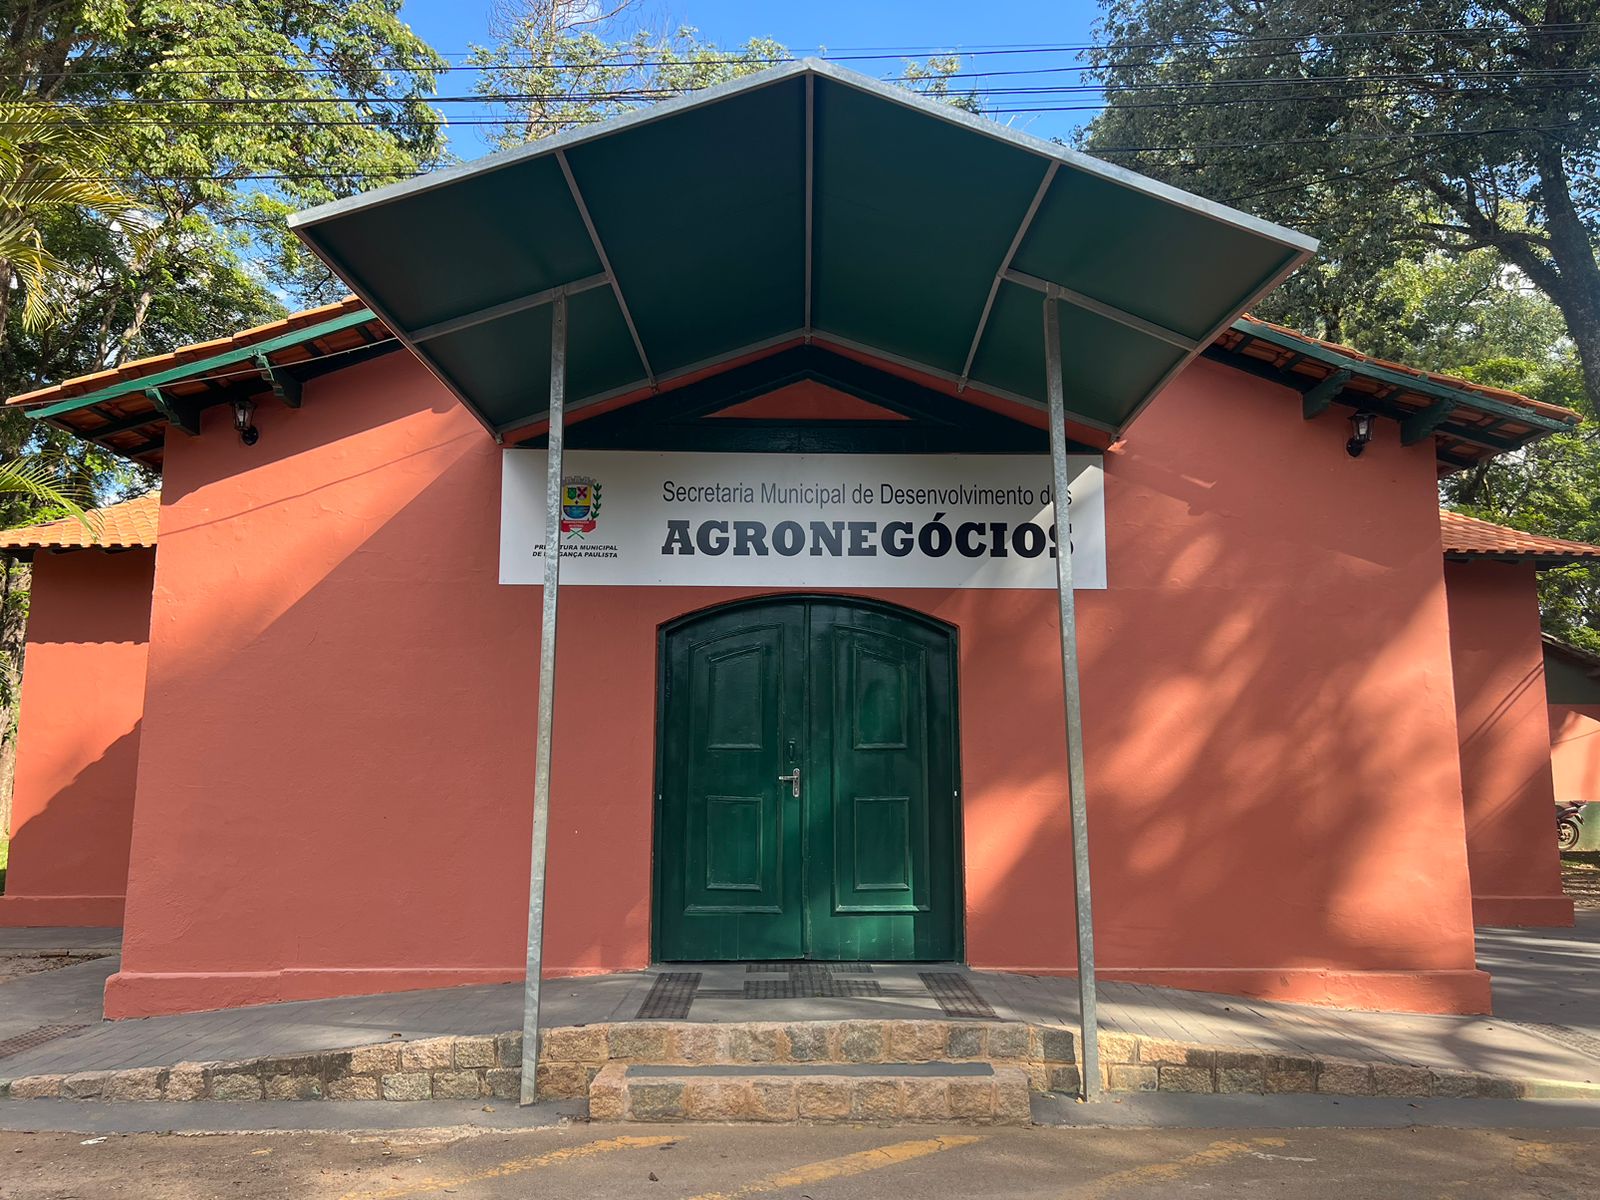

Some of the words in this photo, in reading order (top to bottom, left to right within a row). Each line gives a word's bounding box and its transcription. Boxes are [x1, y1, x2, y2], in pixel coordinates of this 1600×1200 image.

[663, 480, 754, 503] Secretaria
[761, 482, 846, 509] Municipal
[852, 483, 874, 504] de
[880, 484, 1034, 505] Desenvolvimento
[1040, 484, 1073, 505] ds
